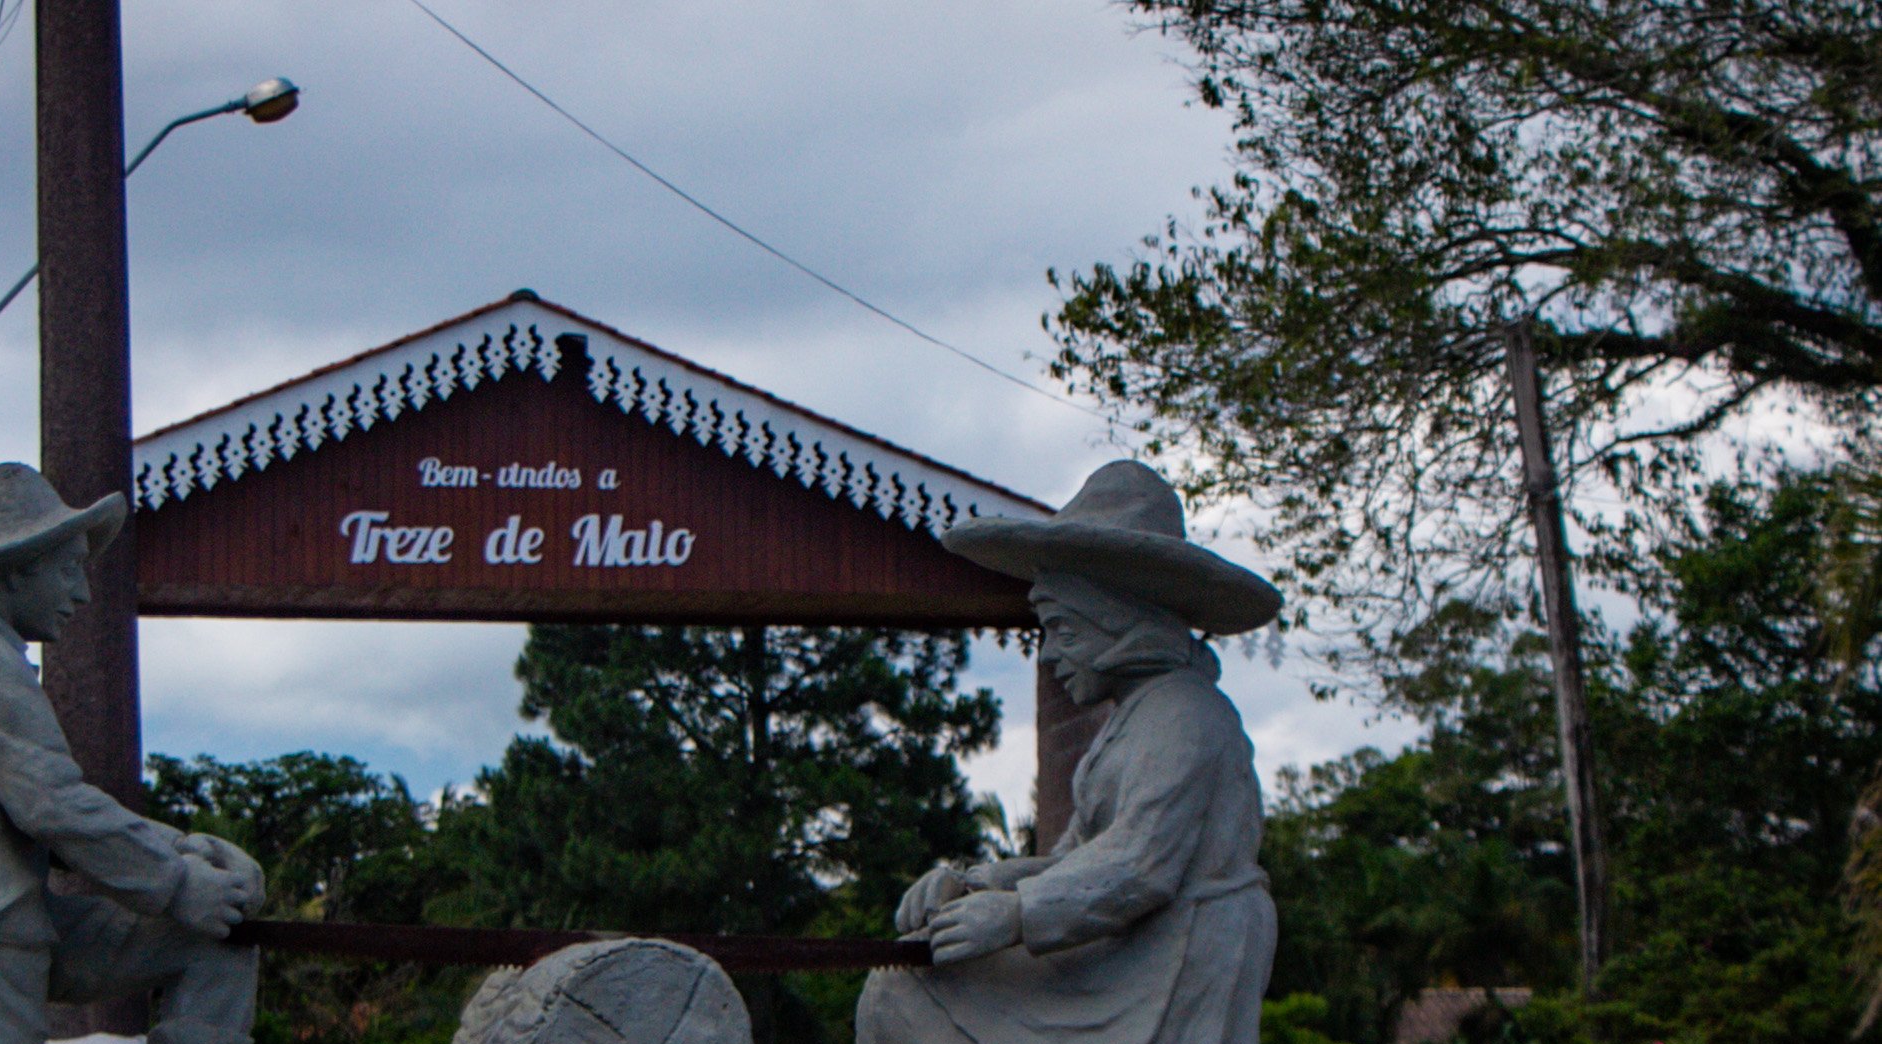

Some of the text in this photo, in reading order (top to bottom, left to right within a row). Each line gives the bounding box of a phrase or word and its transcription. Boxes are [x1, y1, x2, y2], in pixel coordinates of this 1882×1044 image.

[597, 466, 621, 489] a
[340, 511, 697, 567] Treze de Maio
